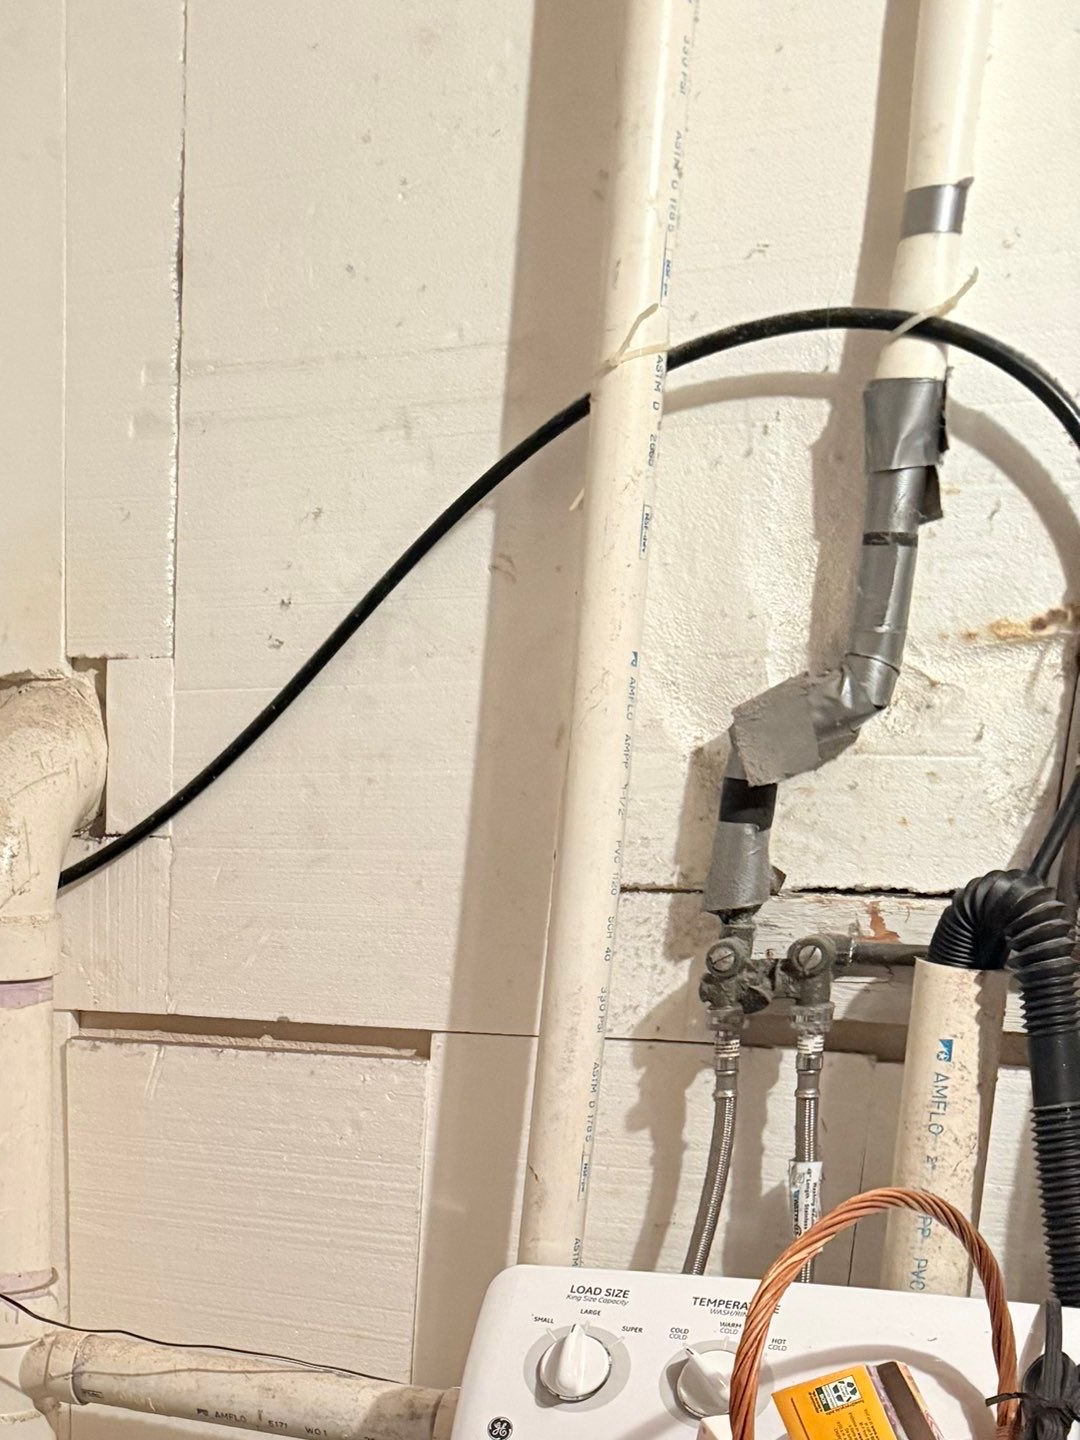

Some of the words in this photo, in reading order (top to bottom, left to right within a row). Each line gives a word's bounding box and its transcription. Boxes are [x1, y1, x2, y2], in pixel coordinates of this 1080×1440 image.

[653, 355, 664, 393] ASTM
[928, 1071, 951, 1137] AMFLO
[909, 1257, 929, 1291] PVC
[570, 1285, 602, 1297] LOAD
[604, 1287, 631, 1299] SIZE
[565, 1294, 582, 1303] King
[583, 1295, 597, 1303] Size
[597, 1296, 630, 1307] Capacity
[692, 1296, 782, 1315] TEMPERAE
[580, 1308, 601, 1317] LARGE
[710, 1308, 748, 1318] WASH/RIN
[534, 1316, 555, 1325] SMALL
[720, 1320, 742, 1329] WARM
[621, 1325, 644, 1334] SUPER
[670, 1326, 690, 1335] COLD
[720, 1327, 739, 1336] COLD
[669, 1333, 688, 1341] COLD
[771, 1337, 787, 1345] HOT
[767, 1343, 787, 1352] COLD
[214, 1411, 247, 1422] AMFLO
